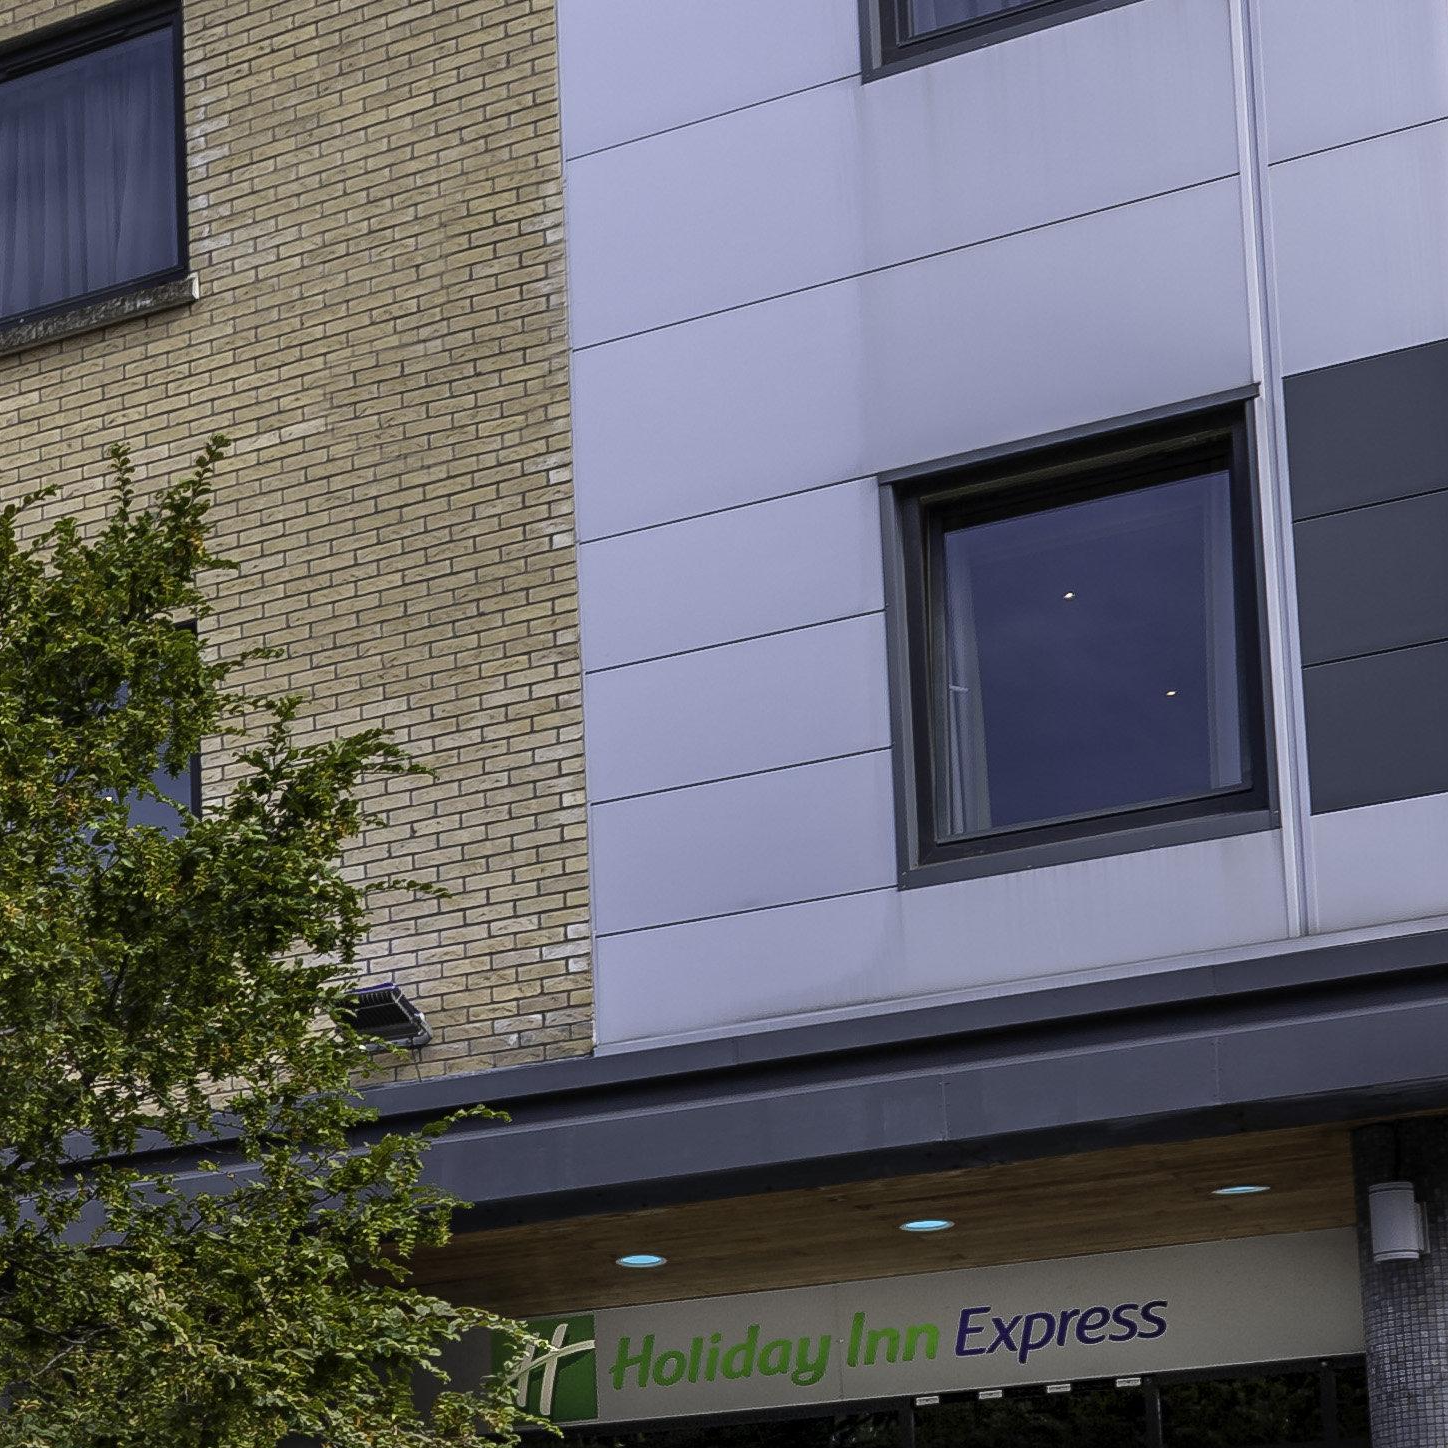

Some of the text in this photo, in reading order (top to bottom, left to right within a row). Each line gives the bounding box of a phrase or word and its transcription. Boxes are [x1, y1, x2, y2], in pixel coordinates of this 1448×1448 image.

[608, 1323, 832, 1390] Holiday
[846, 1311, 940, 1367] Inn
[955, 1299, 1168, 1364] Express
